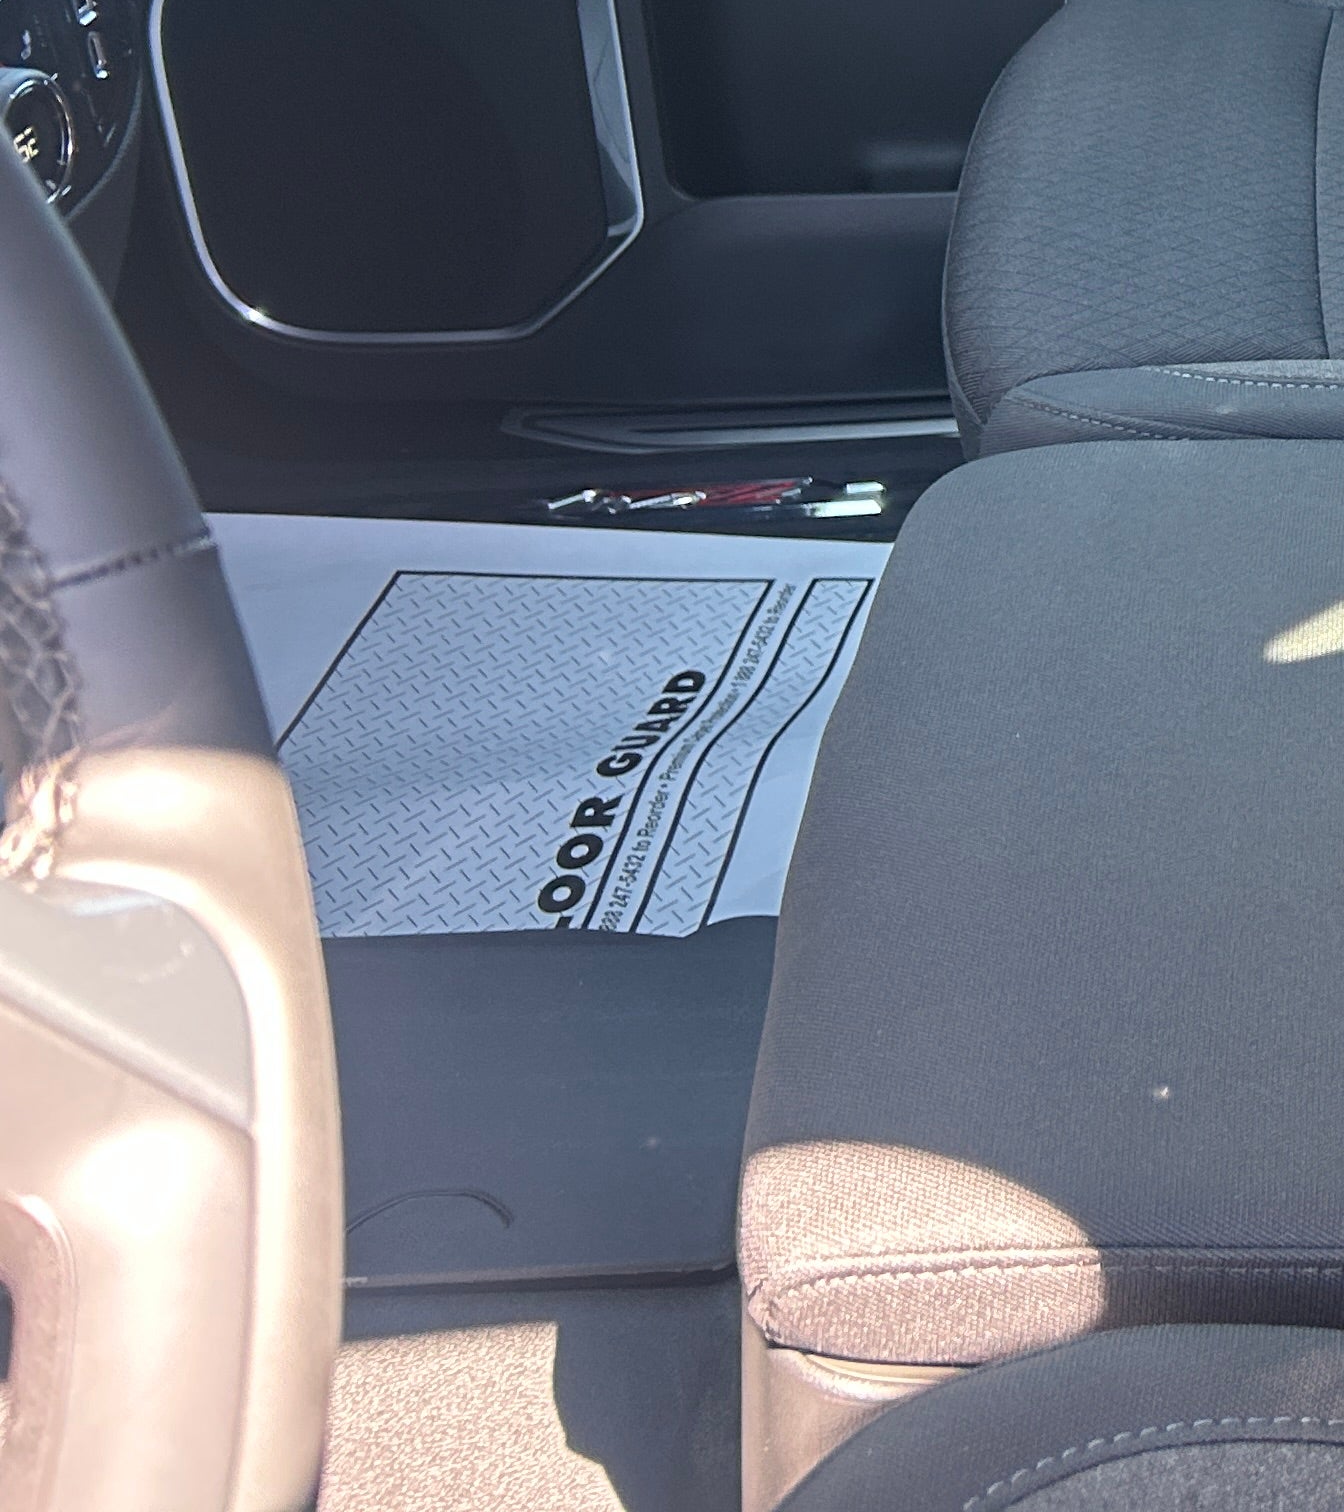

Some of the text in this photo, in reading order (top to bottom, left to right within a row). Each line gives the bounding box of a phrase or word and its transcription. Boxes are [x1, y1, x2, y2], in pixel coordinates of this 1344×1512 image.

[596, 669, 706, 777] GUARD
[637, 788, 670, 839] Reorder
[631, 833, 652, 855] to
